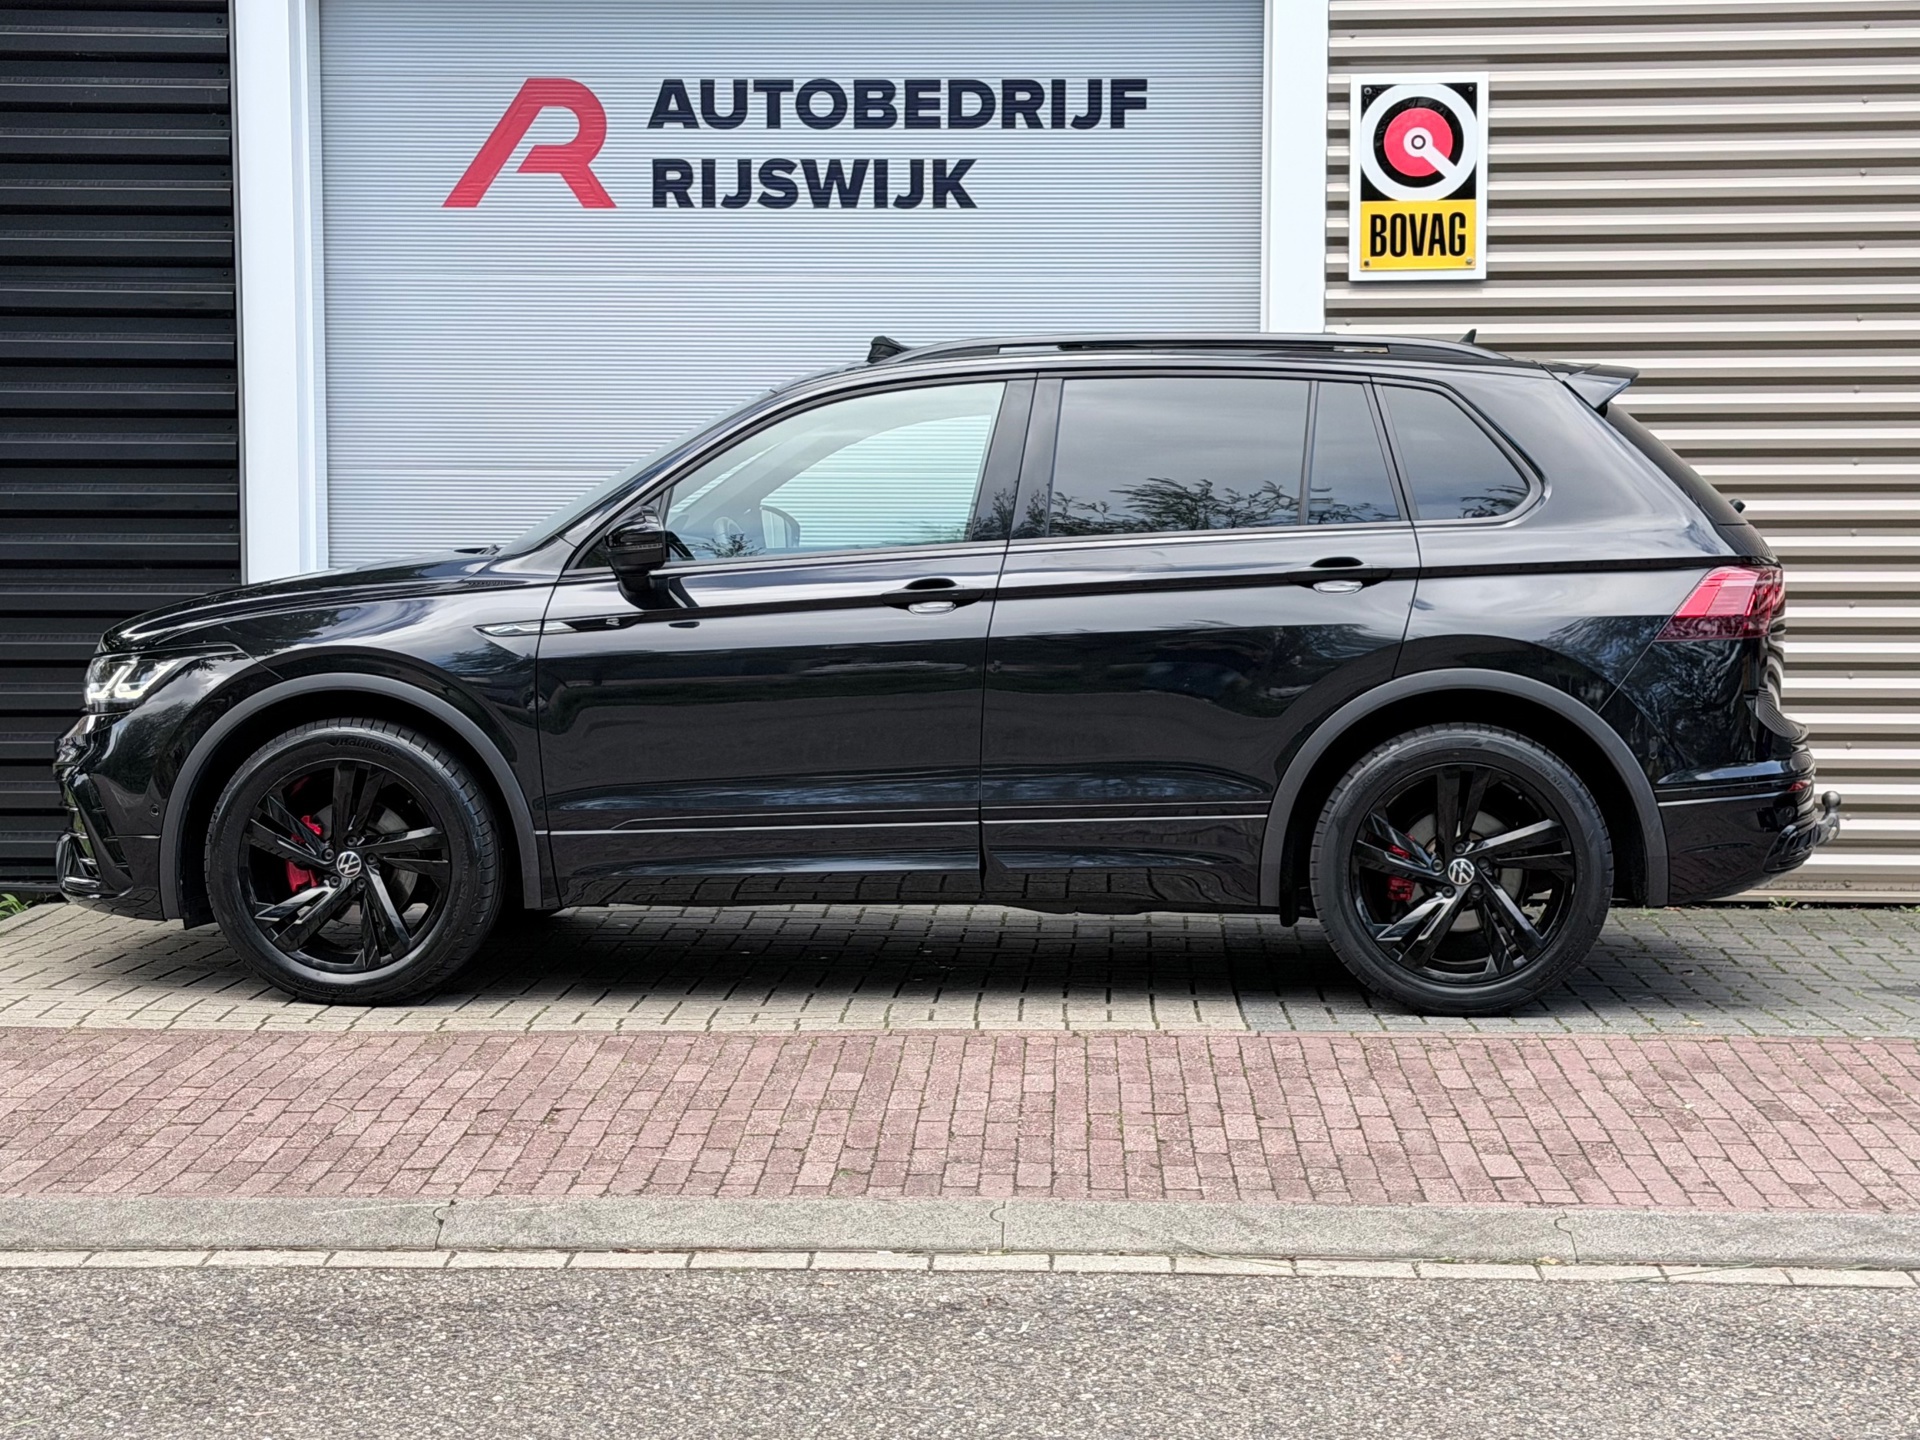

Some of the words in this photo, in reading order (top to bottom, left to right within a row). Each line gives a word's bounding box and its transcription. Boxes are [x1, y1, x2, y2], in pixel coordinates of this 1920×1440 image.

[648, 78, 1148, 130] AUTOBEDRIJF
[652, 158, 977, 210] RIJSWIJK
[1370, 212, 1466, 257] BOVAG
